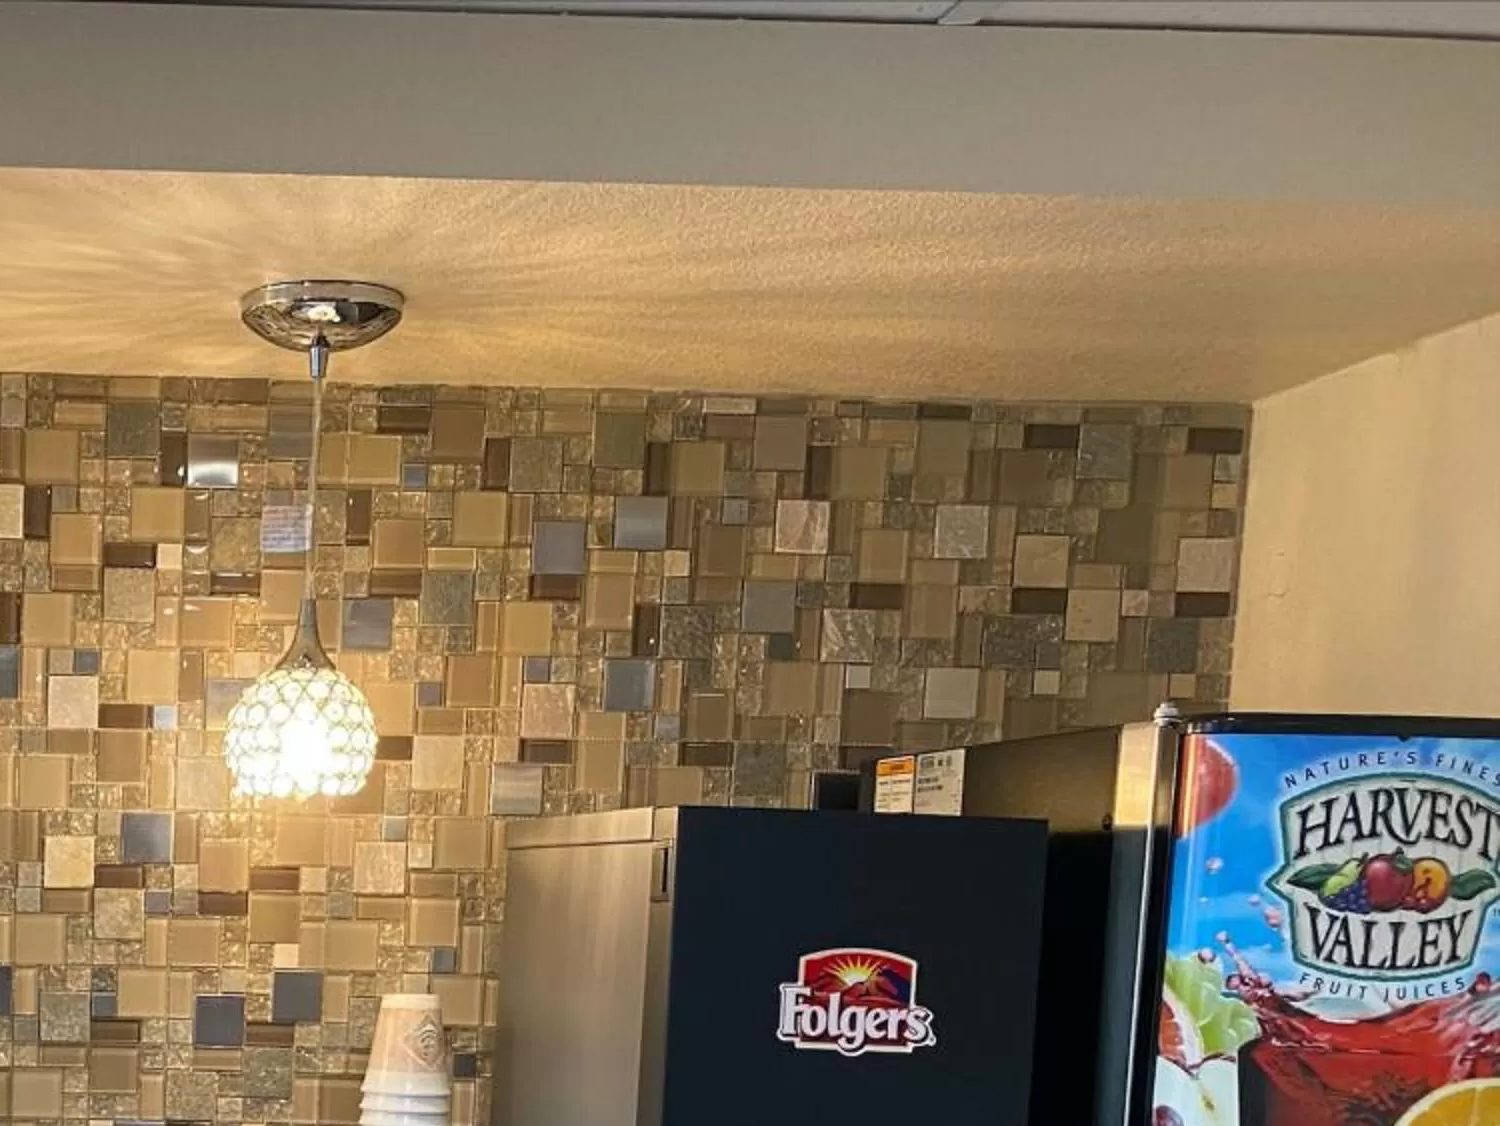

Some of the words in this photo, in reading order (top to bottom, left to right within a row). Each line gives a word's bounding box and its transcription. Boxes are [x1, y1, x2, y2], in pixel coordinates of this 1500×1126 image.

[1284, 750, 1417, 789] NATURE'S
[1434, 753, 1500, 788] FINES
[1293, 786, 1500, 861] HARVEST
[1302, 900, 1474, 971] VALLEY
[779, 983, 932, 1051] Folgers
[1299, 971, 1367, 1001] FRUIT
[1382, 976, 1467, 1002] JUICES
